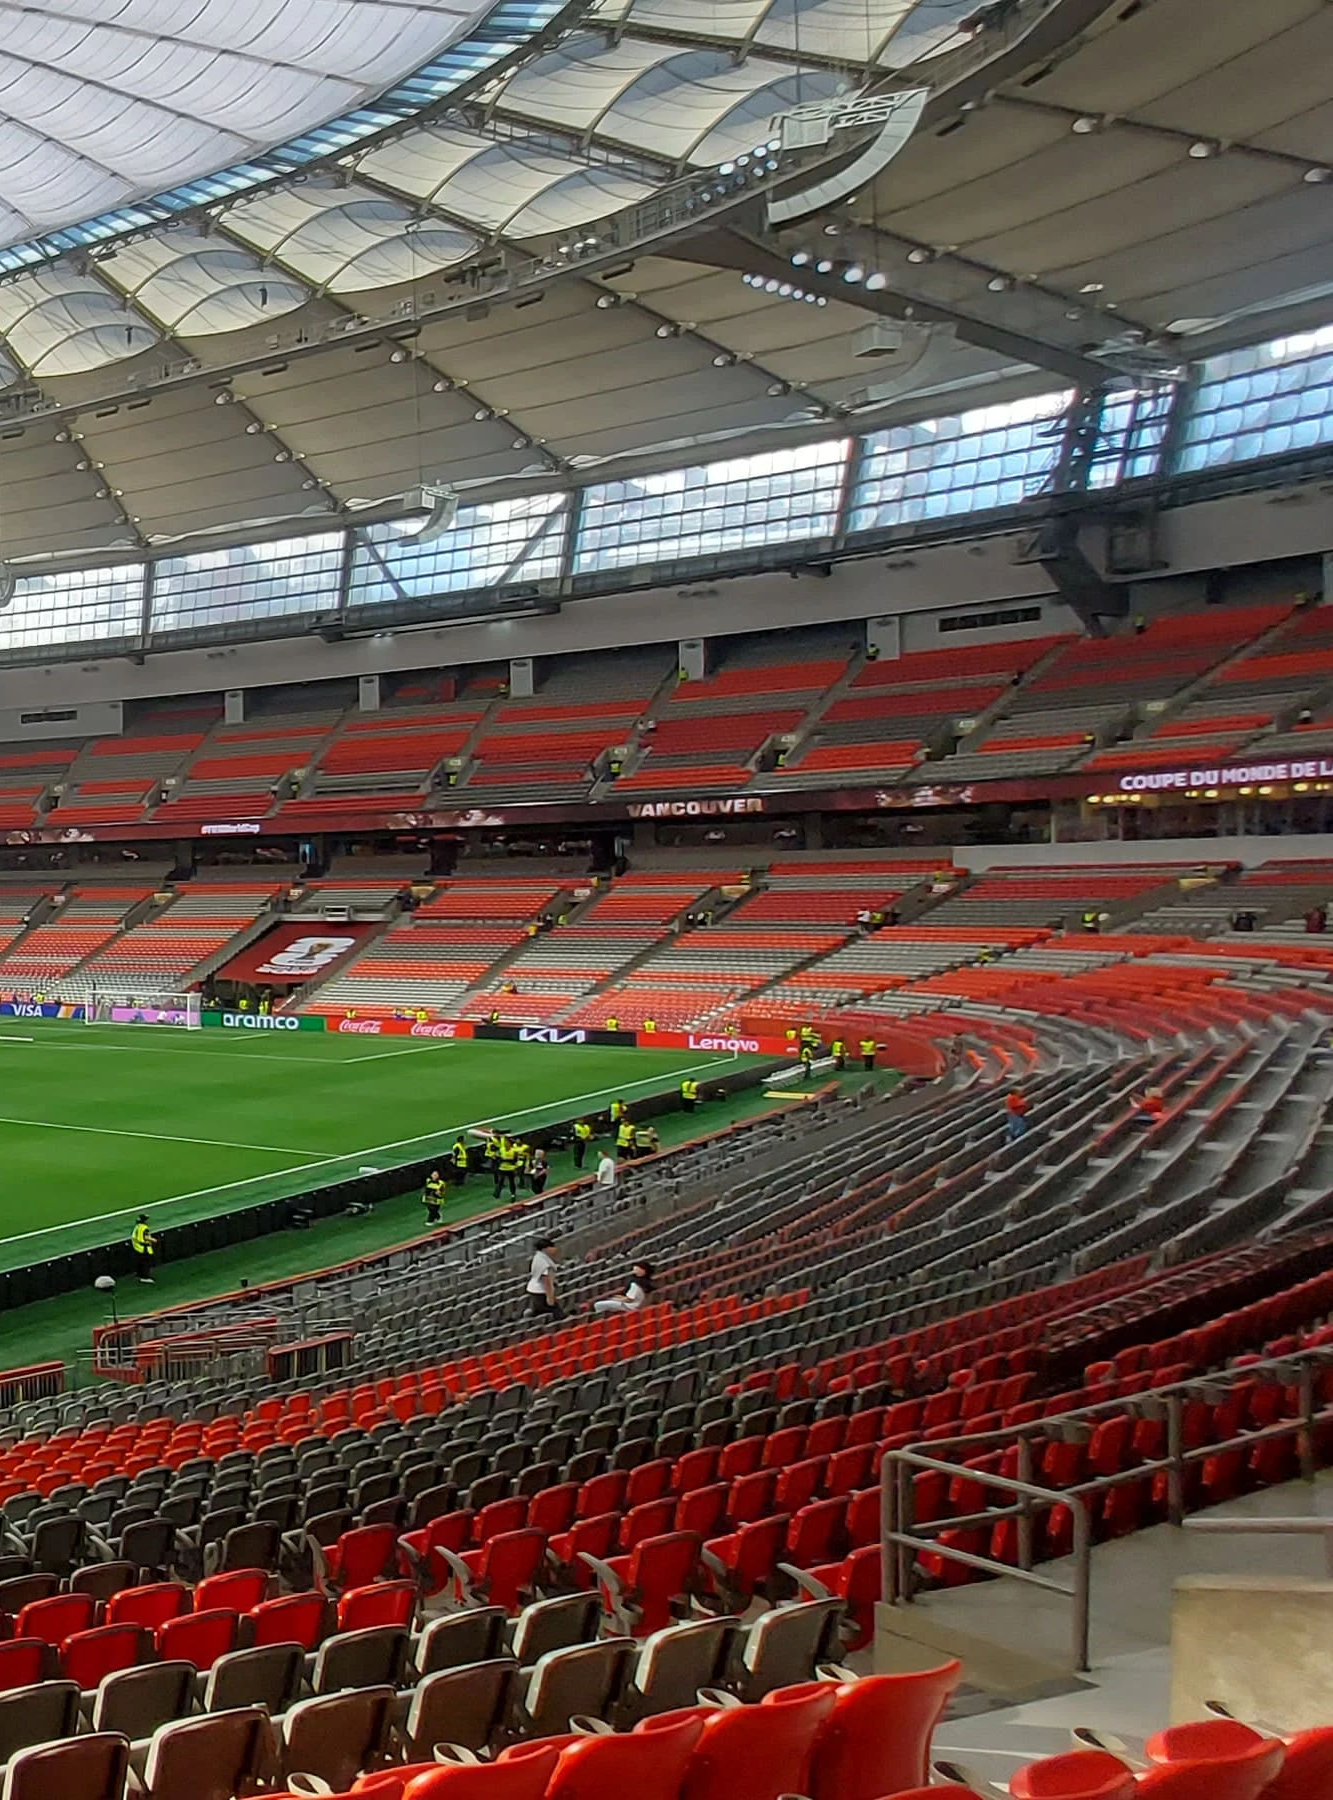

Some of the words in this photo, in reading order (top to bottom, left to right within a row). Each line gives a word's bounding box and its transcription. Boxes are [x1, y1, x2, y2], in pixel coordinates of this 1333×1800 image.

[1121, 773, 1187, 790] COUPE
[1190, 770, 1218, 786] DU
[1222, 765, 1287, 783] MONDE
[1291, 763, 1317, 778] DE
[627, 799, 765, 817] VANCOUVER
[12, 1004, 43, 1017] VISA
[223, 1014, 299, 1030] aramco
[689, 1035, 758, 1052] Lenovo
